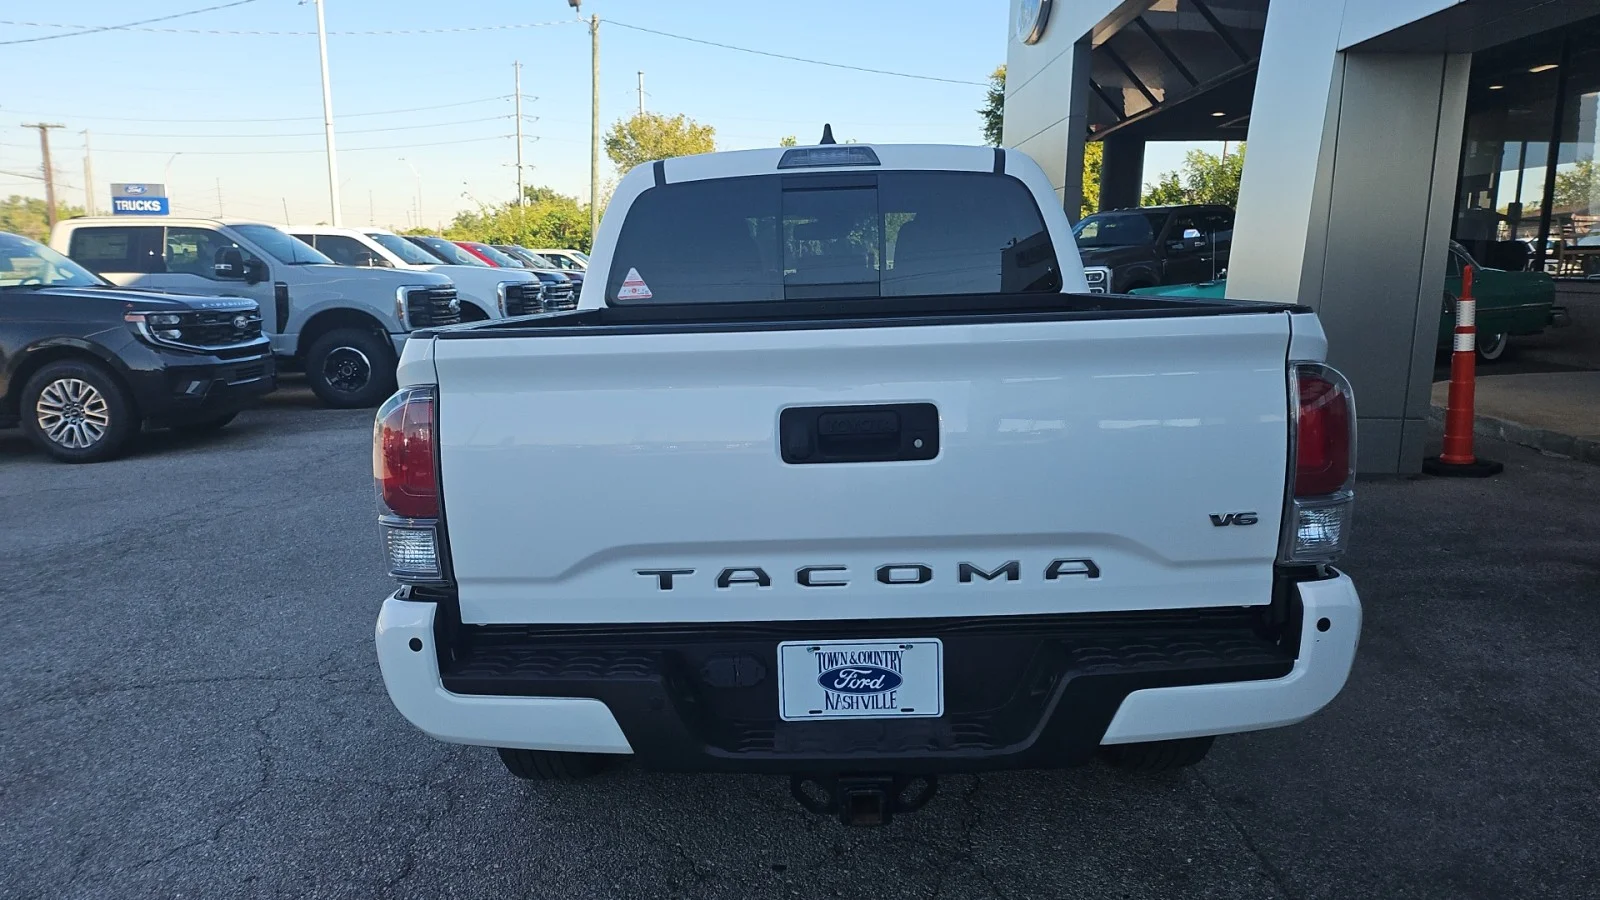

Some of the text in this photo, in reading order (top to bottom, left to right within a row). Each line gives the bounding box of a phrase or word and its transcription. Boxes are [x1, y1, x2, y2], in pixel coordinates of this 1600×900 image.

[115, 200, 161, 211] TRUCKS
[1208, 511, 1258, 527] V6
[634, 558, 1101, 590] TACOMA
[815, 651, 904, 673] TOWN & COUNTRY
[834, 668, 885, 690] Ford
[824, 690, 898, 710] NASHVILLE
